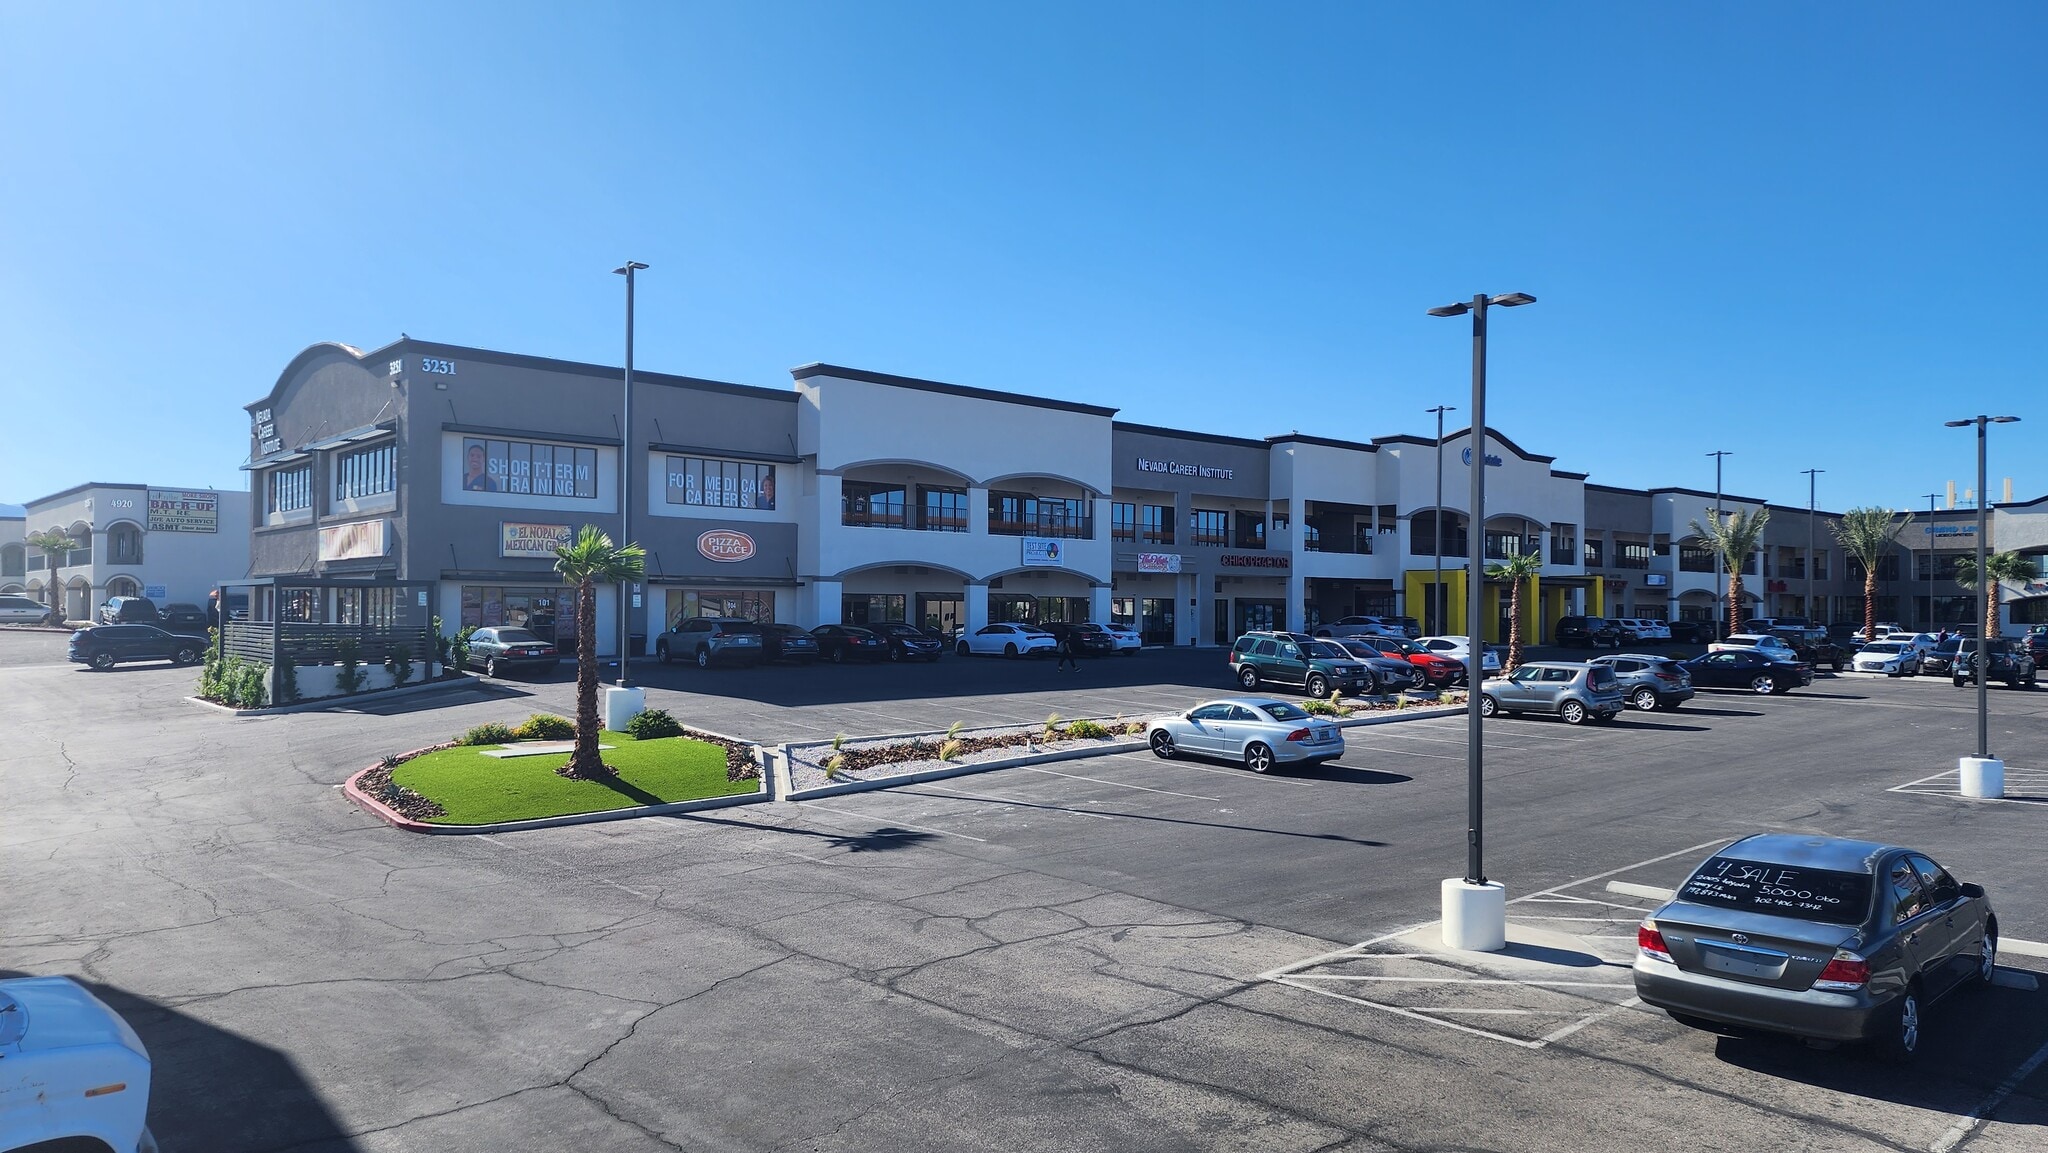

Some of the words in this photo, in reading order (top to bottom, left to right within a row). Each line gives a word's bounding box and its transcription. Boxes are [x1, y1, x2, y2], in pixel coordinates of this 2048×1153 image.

[422, 358, 457, 375] 3231
[488, 458, 588, 481] SHORT-TERM
[669, 472, 694, 489] FOR
[704, 475, 765, 494] MEDICAL
[111, 499, 133, 508] 4920
[685, 489, 749, 508] CAREERS
[518, 526, 529, 539] EL
[530, 526, 558, 539] NOPAL
[505, 539, 544, 551] MEXICAN
[708, 537, 741, 546] PIZZA
[712, 545, 748, 554] PLACE
[1717, 861, 1732, 876] 4
[1729, 865, 1800, 887] SALE
